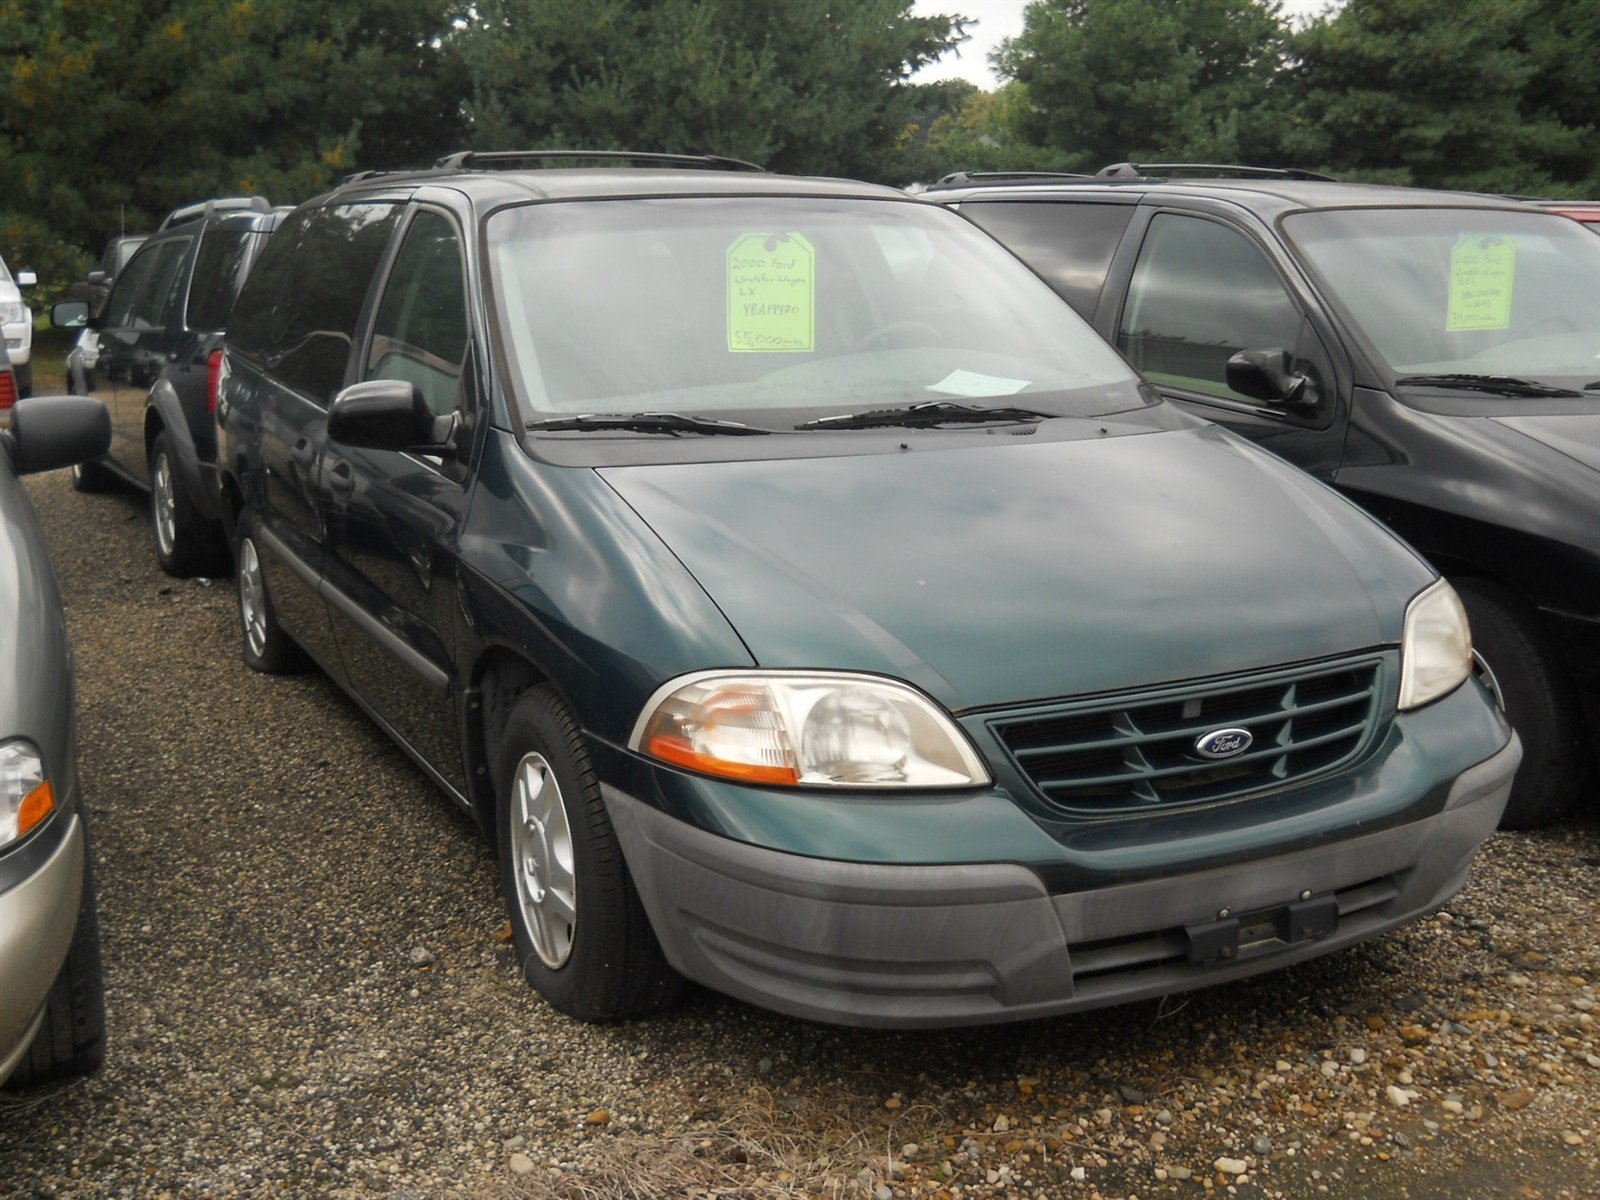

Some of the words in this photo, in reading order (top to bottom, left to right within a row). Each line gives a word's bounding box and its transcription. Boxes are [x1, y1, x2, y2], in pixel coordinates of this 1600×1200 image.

[732, 257, 766, 270] 2000
[772, 257, 796, 269] Ford
[1212, 734, 1241, 753] Ford
